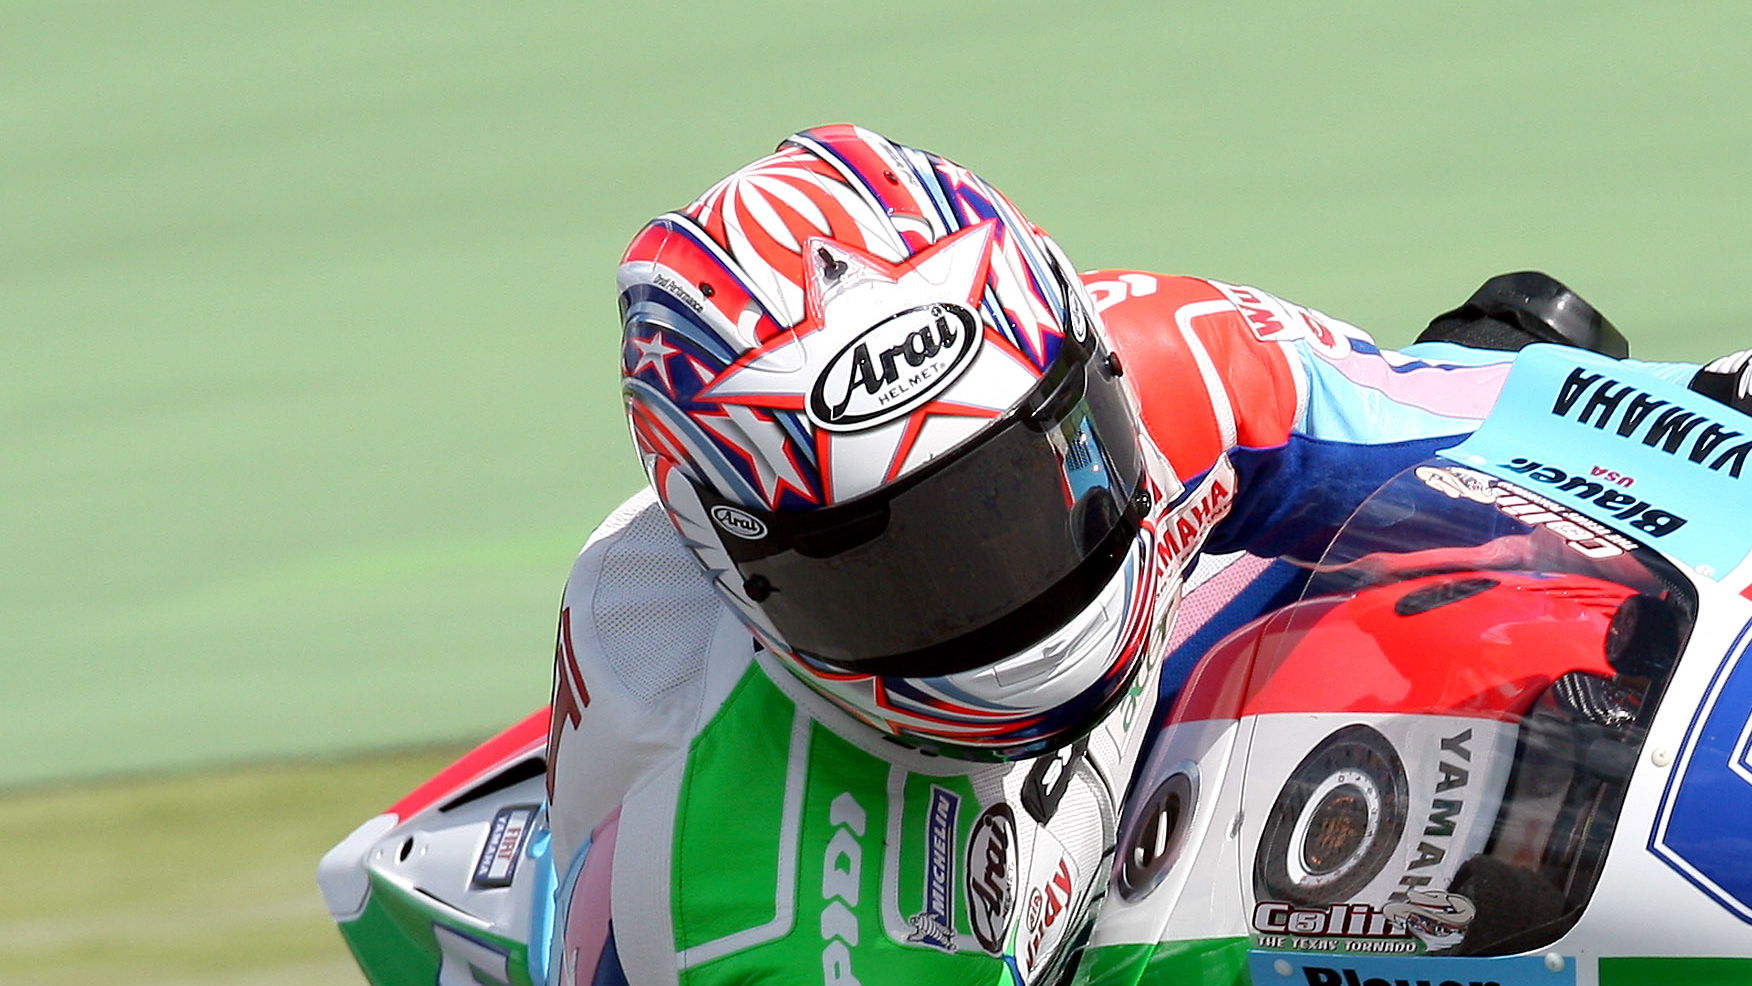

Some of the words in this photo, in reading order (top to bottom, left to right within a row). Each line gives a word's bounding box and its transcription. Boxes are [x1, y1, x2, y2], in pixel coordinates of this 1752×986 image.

[832, 306, 957, 420] Arai
[878, 363, 940, 406] HELMET
[1590, 464, 1635, 488] USA
[719, 510, 758, 532] Arai
[1156, 480, 1229, 578] MAHA
[478, 815, 508, 876] YAMAHA
[498, 827, 522, 861] FIAT
[1390, 728, 1473, 904] YAMAH
[931, 796, 951, 917] MICHELIN
[971, 815, 1009, 946] Arai
[1258, 936, 1286, 948] THE
[1344, 940, 1417, 953] TORNADO
